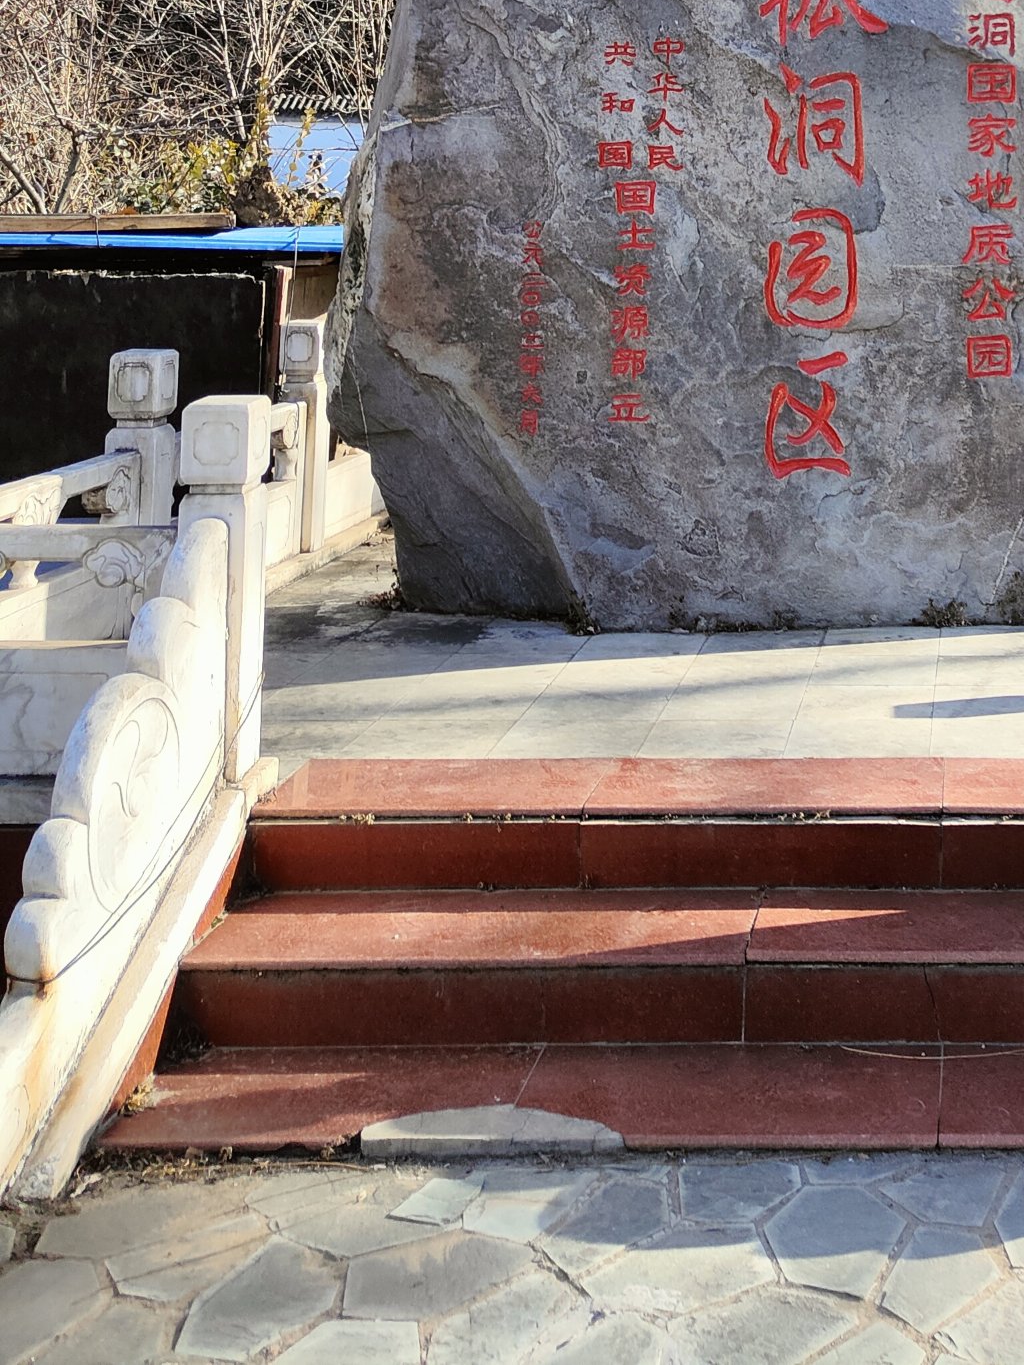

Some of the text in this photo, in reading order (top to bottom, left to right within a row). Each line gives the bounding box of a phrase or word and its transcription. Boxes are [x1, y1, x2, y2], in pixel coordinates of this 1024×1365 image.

[597, 41, 636, 170] 共和国
[647, 36, 685, 172] 中华人民
[607, 179, 657, 424] 国土资源部立
